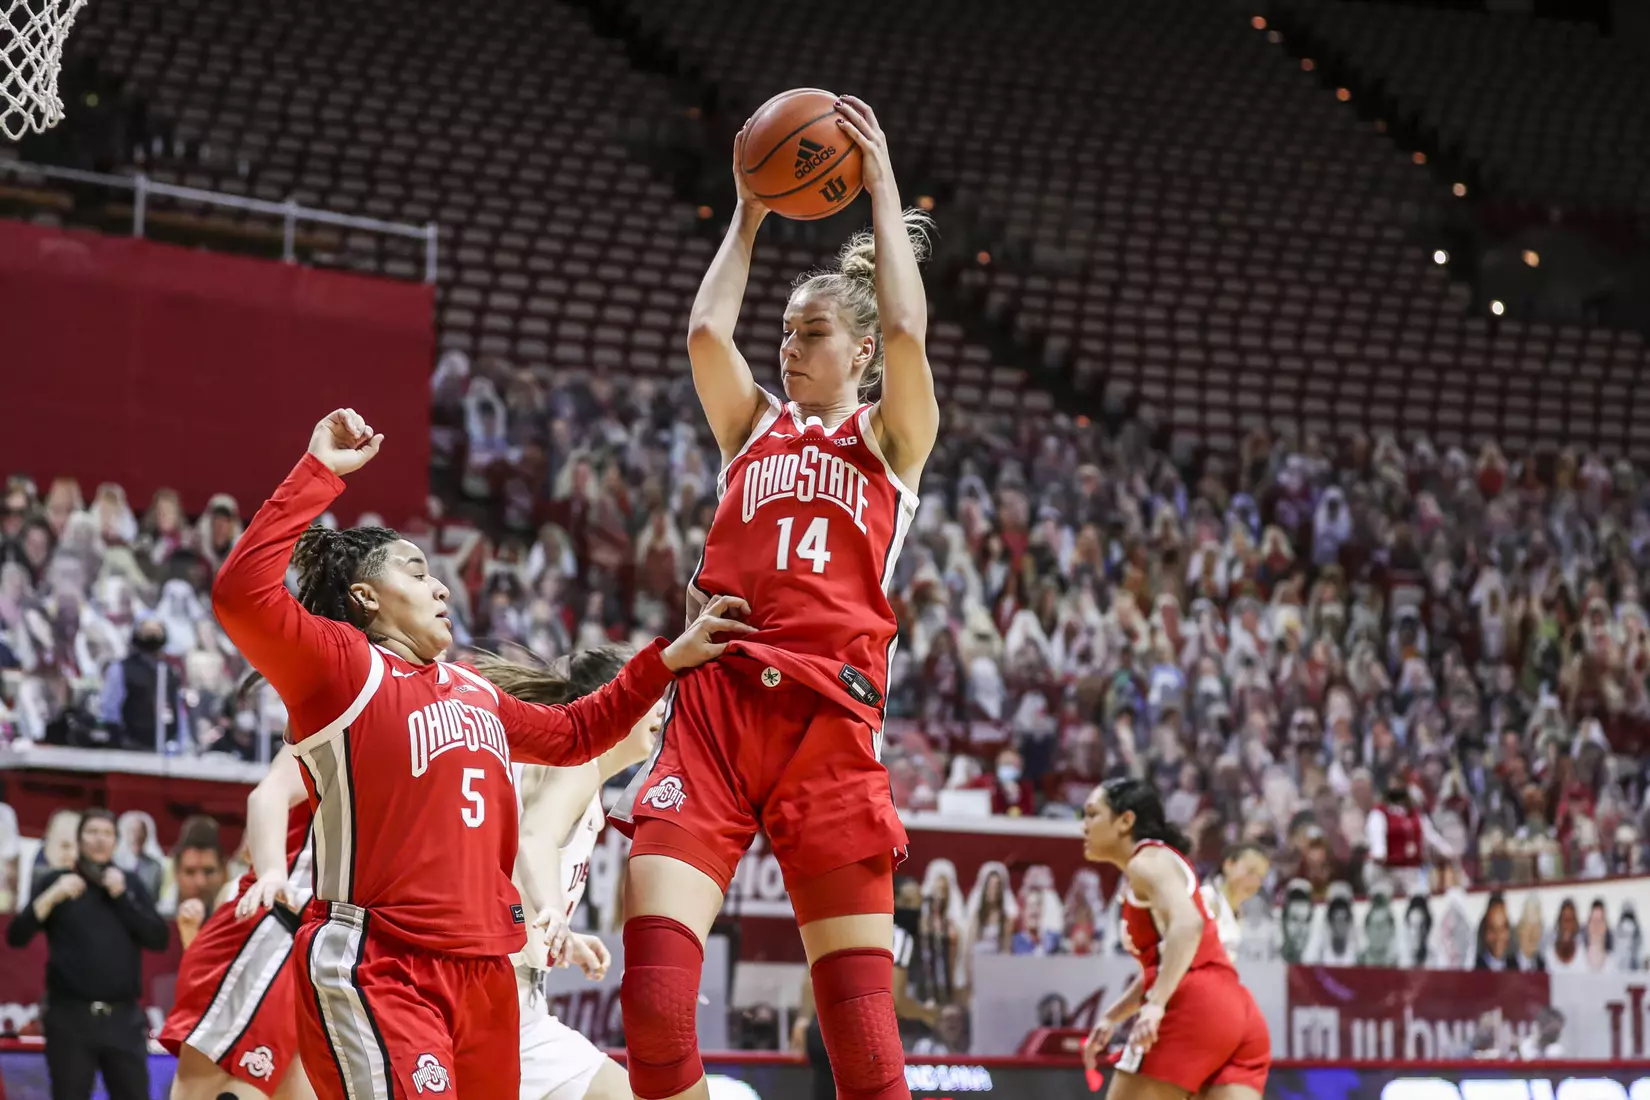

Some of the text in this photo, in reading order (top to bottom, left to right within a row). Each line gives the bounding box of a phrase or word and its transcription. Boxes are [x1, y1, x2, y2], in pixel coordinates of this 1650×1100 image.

[794, 146, 837, 180] adidas
[776, 516, 831, 574] 14
[460, 767, 485, 828] 5
